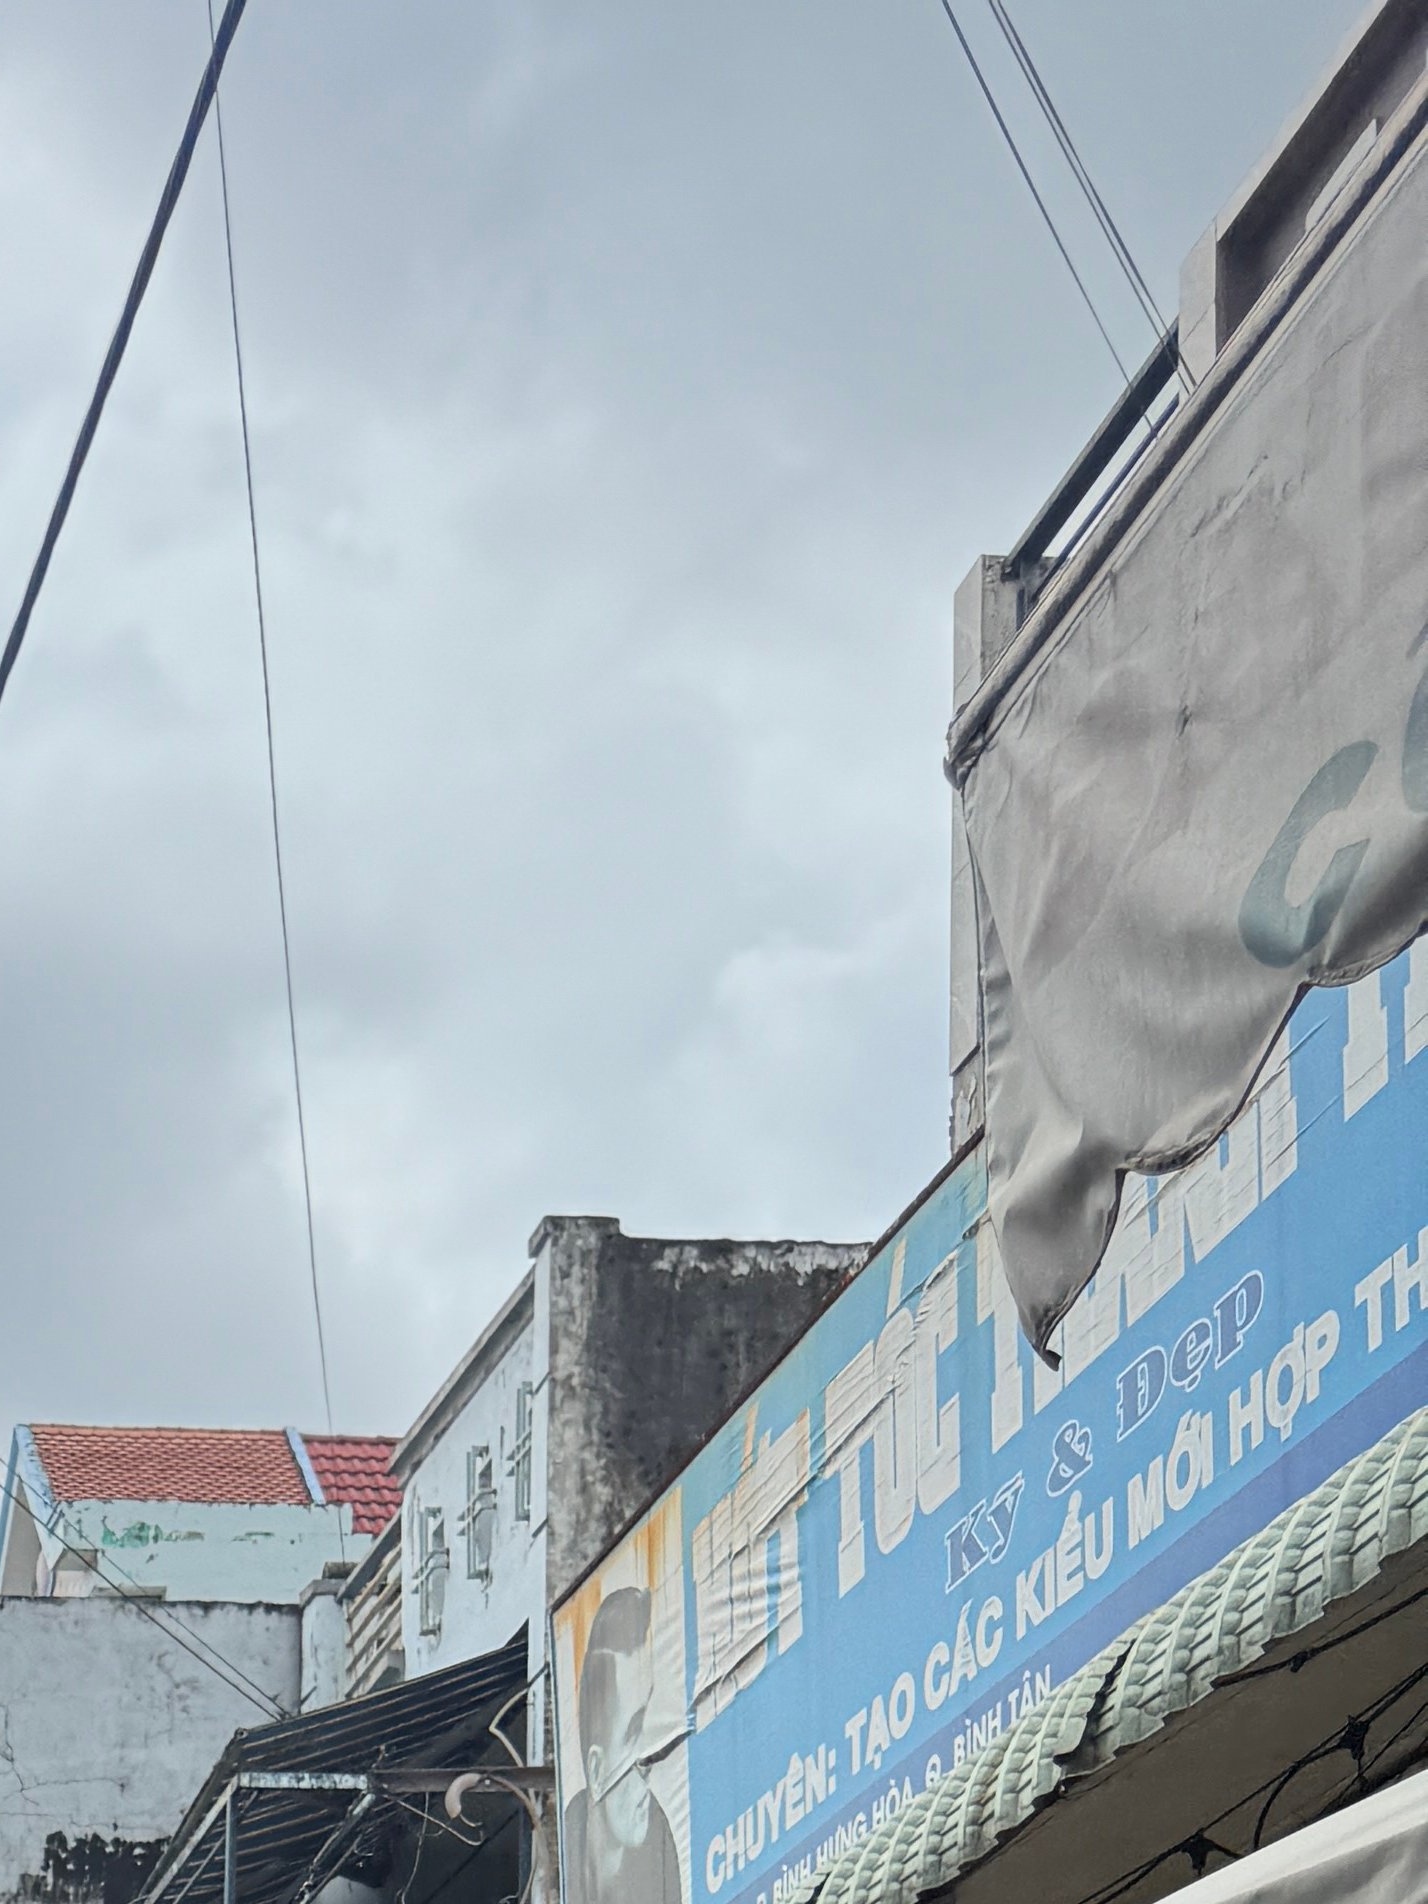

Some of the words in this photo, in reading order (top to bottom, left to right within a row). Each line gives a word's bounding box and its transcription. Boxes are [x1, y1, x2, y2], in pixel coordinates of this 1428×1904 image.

[824, 1240, 960, 1598] TÓC
[1047, 1419, 1093, 1497] &
[1117, 1270, 1263, 1441] Đẹp
[705, 1743, 836, 1894] CHUYÊN:
[845, 1672, 915, 1777] TẠO
[924, 1594, 1004, 1711] CÁC
[1016, 1490, 1113, 1640] KIỂU
[1128, 1410, 1213, 1549] MỚI
[1229, 1310, 1340, 1465] HỢP
[953, 1706, 1003, 1765] BÌNH
[1007, 1664, 1052, 1728] TÂN
